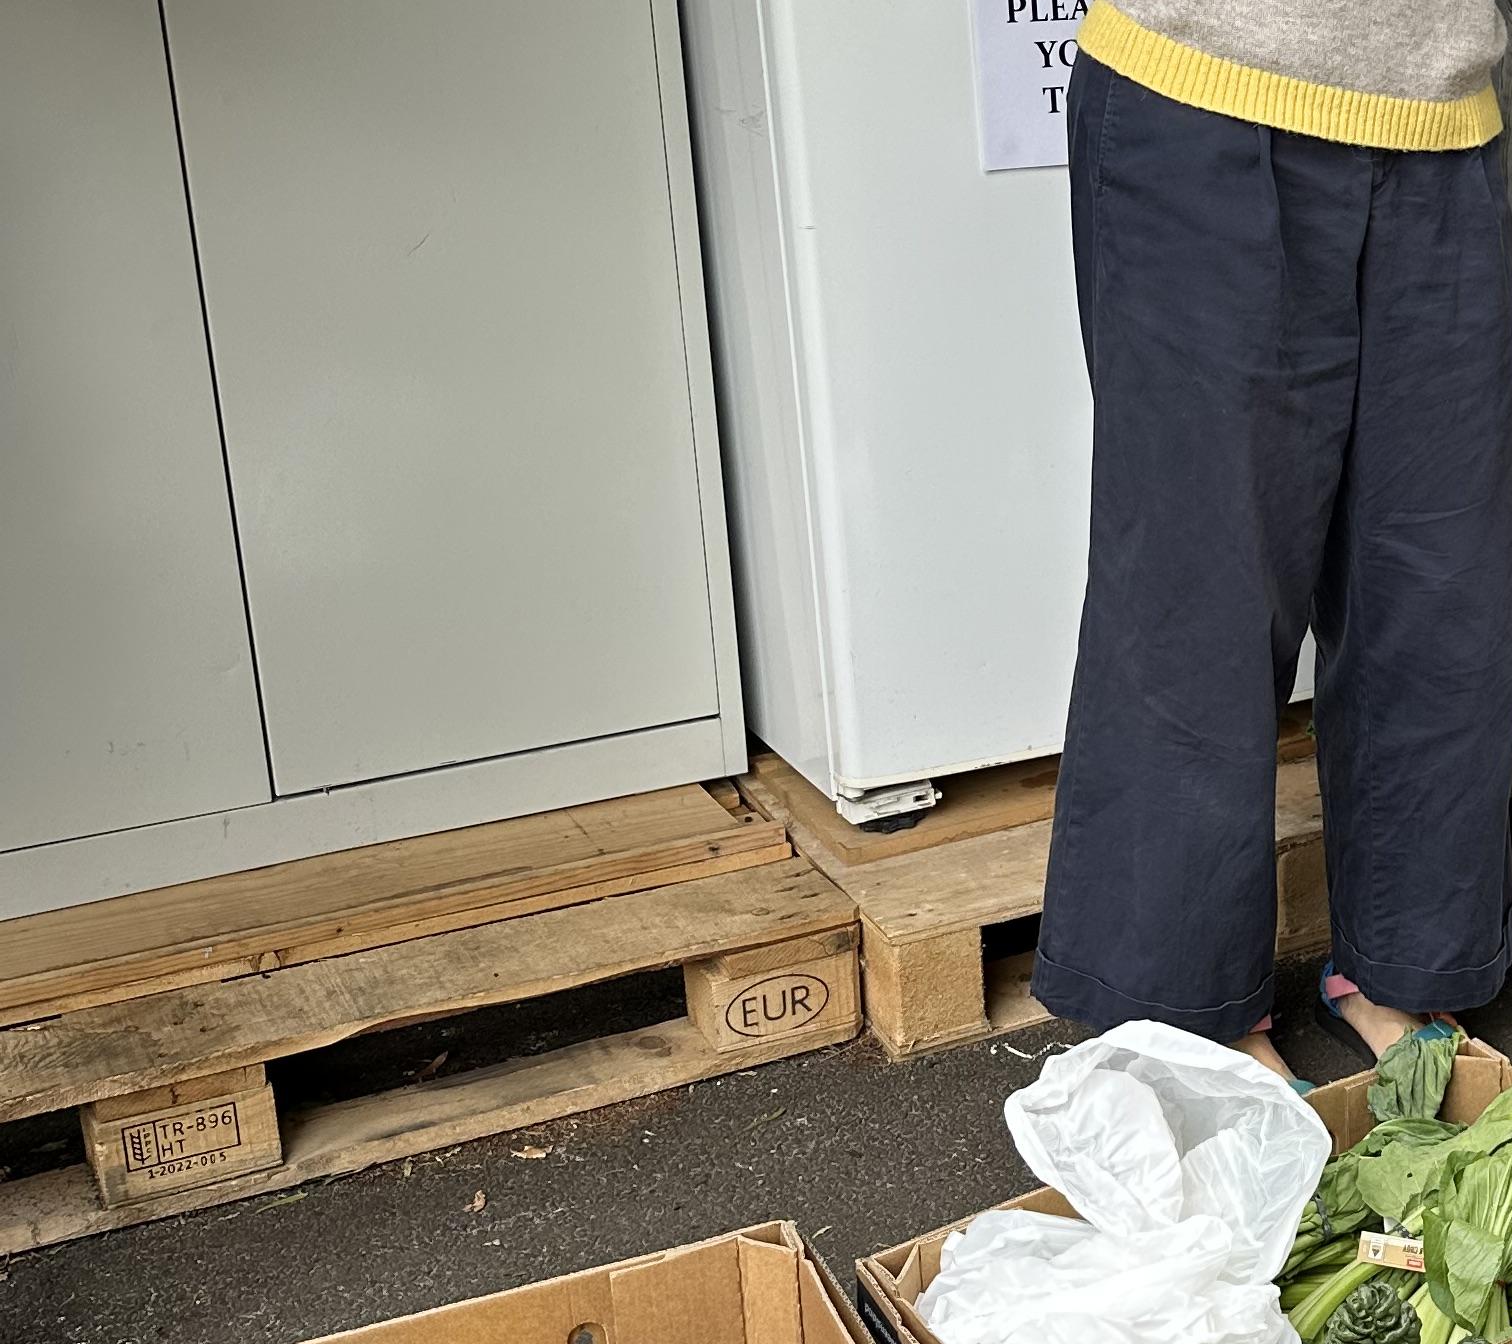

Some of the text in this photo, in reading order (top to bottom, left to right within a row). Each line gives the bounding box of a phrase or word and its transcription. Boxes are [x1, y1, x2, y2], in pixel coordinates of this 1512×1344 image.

[741, 985, 813, 1029] EUR
[159, 1109, 233, 1140] TR-896
[161, 1138, 186, 1158] HT
